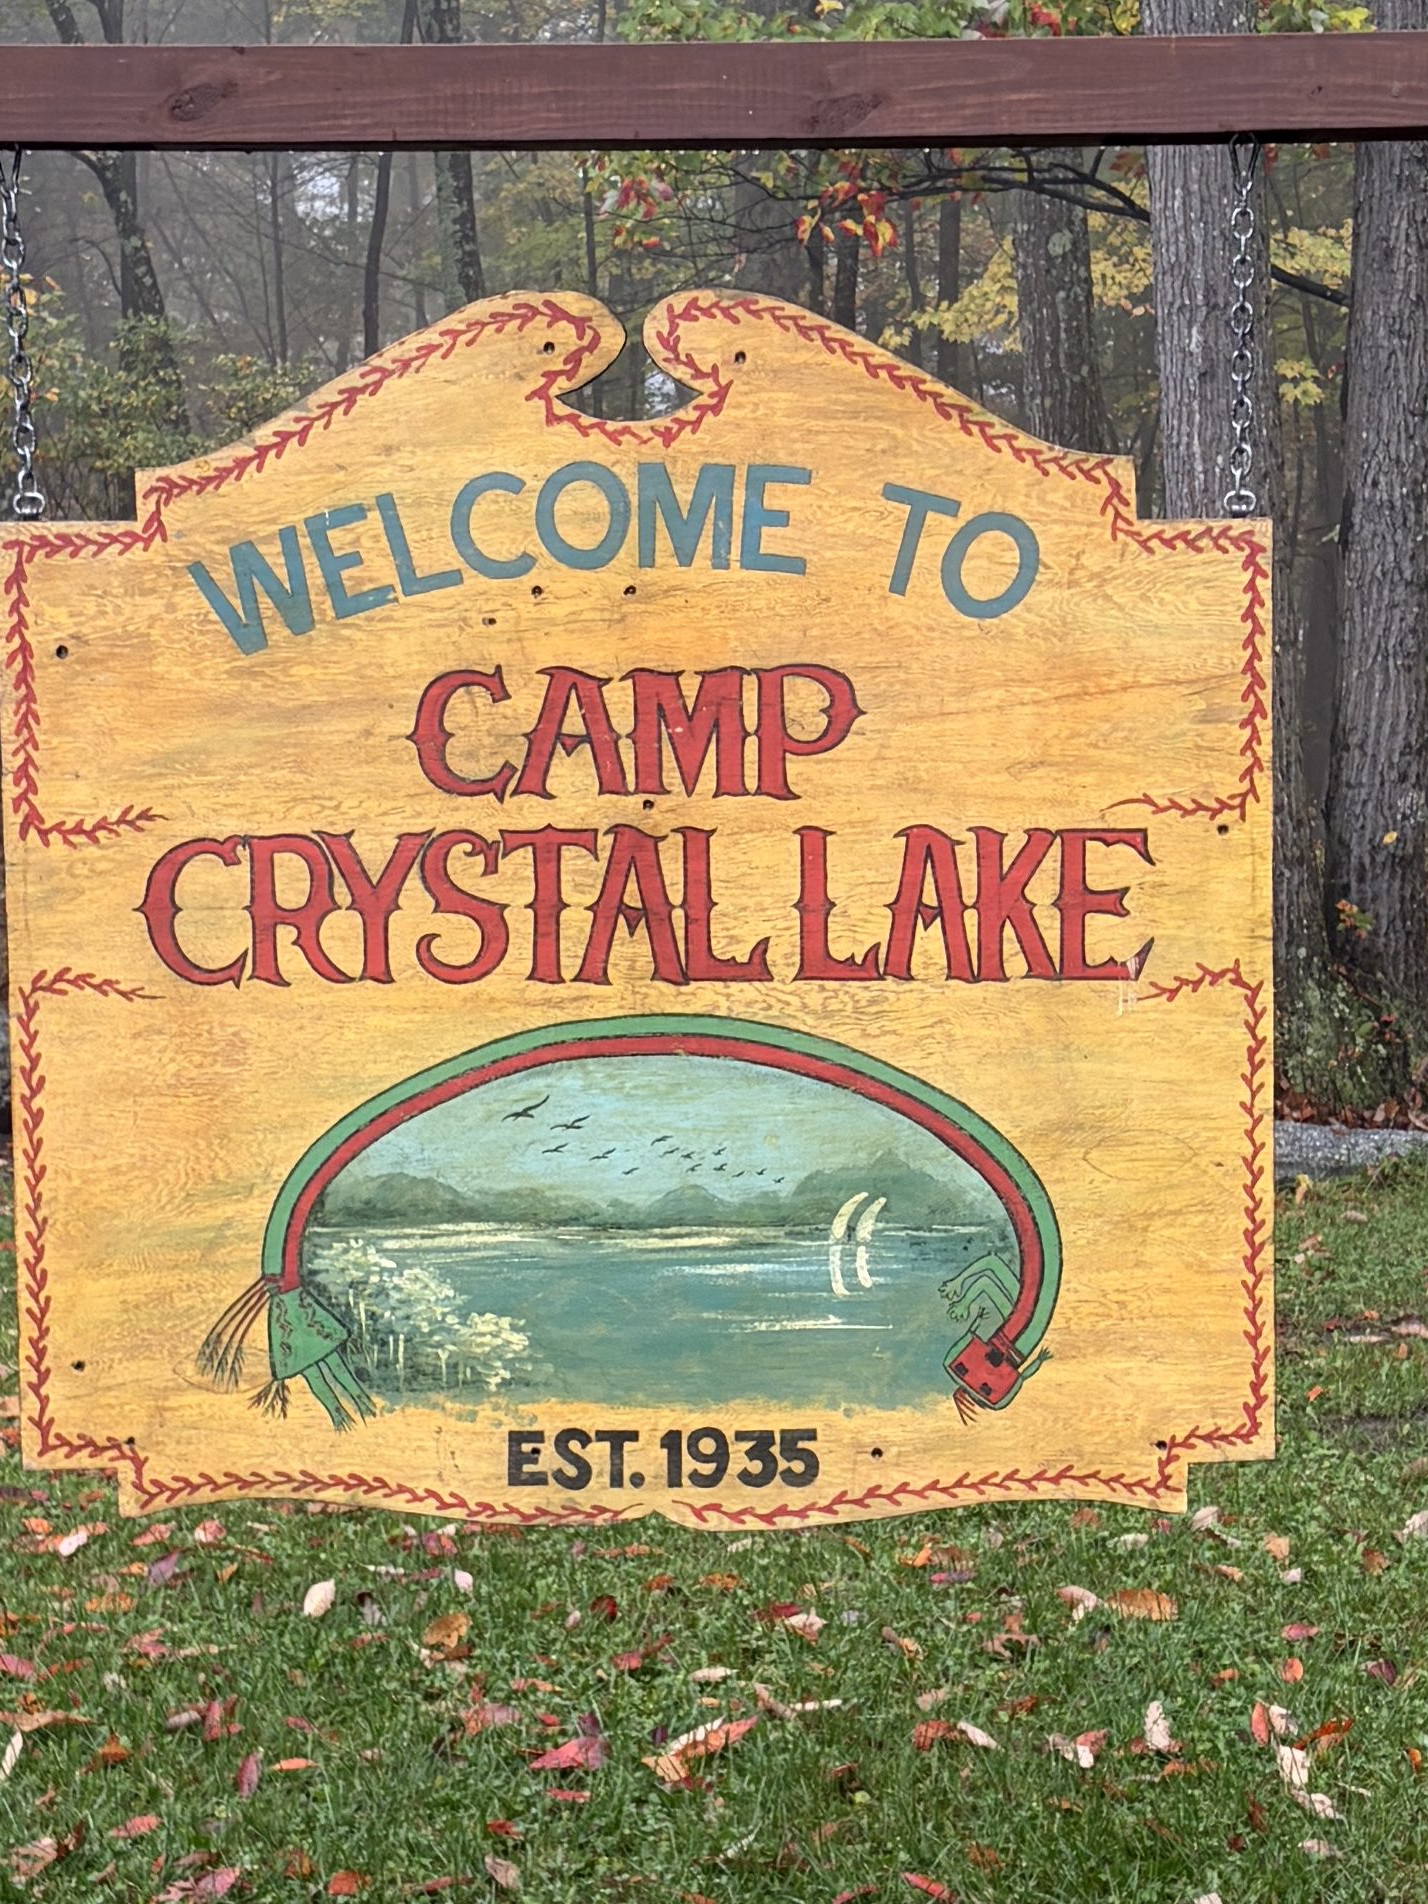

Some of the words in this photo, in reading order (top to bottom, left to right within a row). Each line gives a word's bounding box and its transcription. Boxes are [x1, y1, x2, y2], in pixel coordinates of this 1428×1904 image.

[186, 459, 813, 657] WELCOME
[881, 483, 1041, 621] TO
[406, 663, 868, 801] CAMP
[133, 823, 773, 989] CRYSTAL
[791, 825, 1155, 984] LAKE
[506, 1426, 647, 1492] EST.
[659, 1425, 821, 1490] 1935
